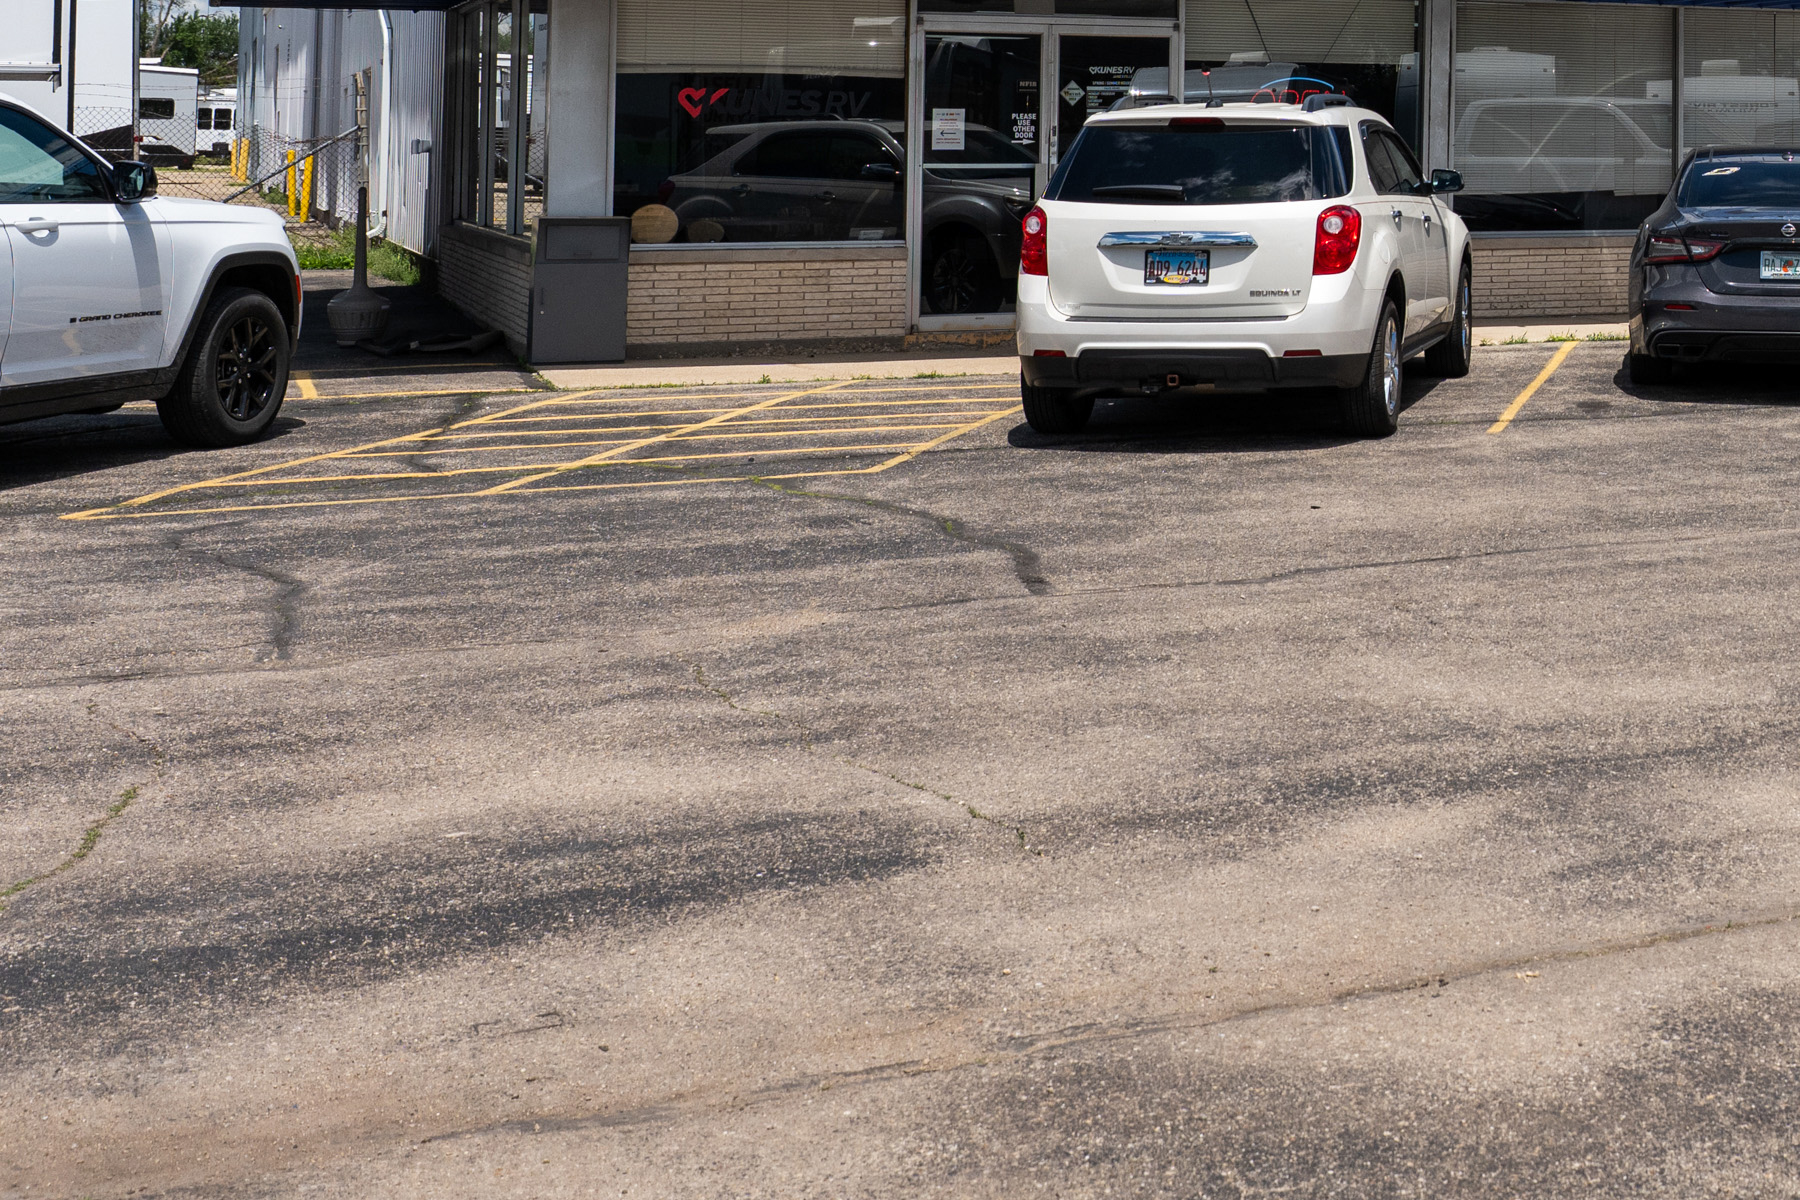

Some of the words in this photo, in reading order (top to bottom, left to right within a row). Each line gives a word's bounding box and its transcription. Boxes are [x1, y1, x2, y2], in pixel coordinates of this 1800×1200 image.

[1095, 66, 1123, 74] KUNES
[1123, 66, 1135, 74] RV
[823, 90, 873, 118] RV
[1014, 131, 1034, 139] DOOR
[79, 314, 111, 322] GRAND
[113, 310, 162, 320] CHEROKEE
